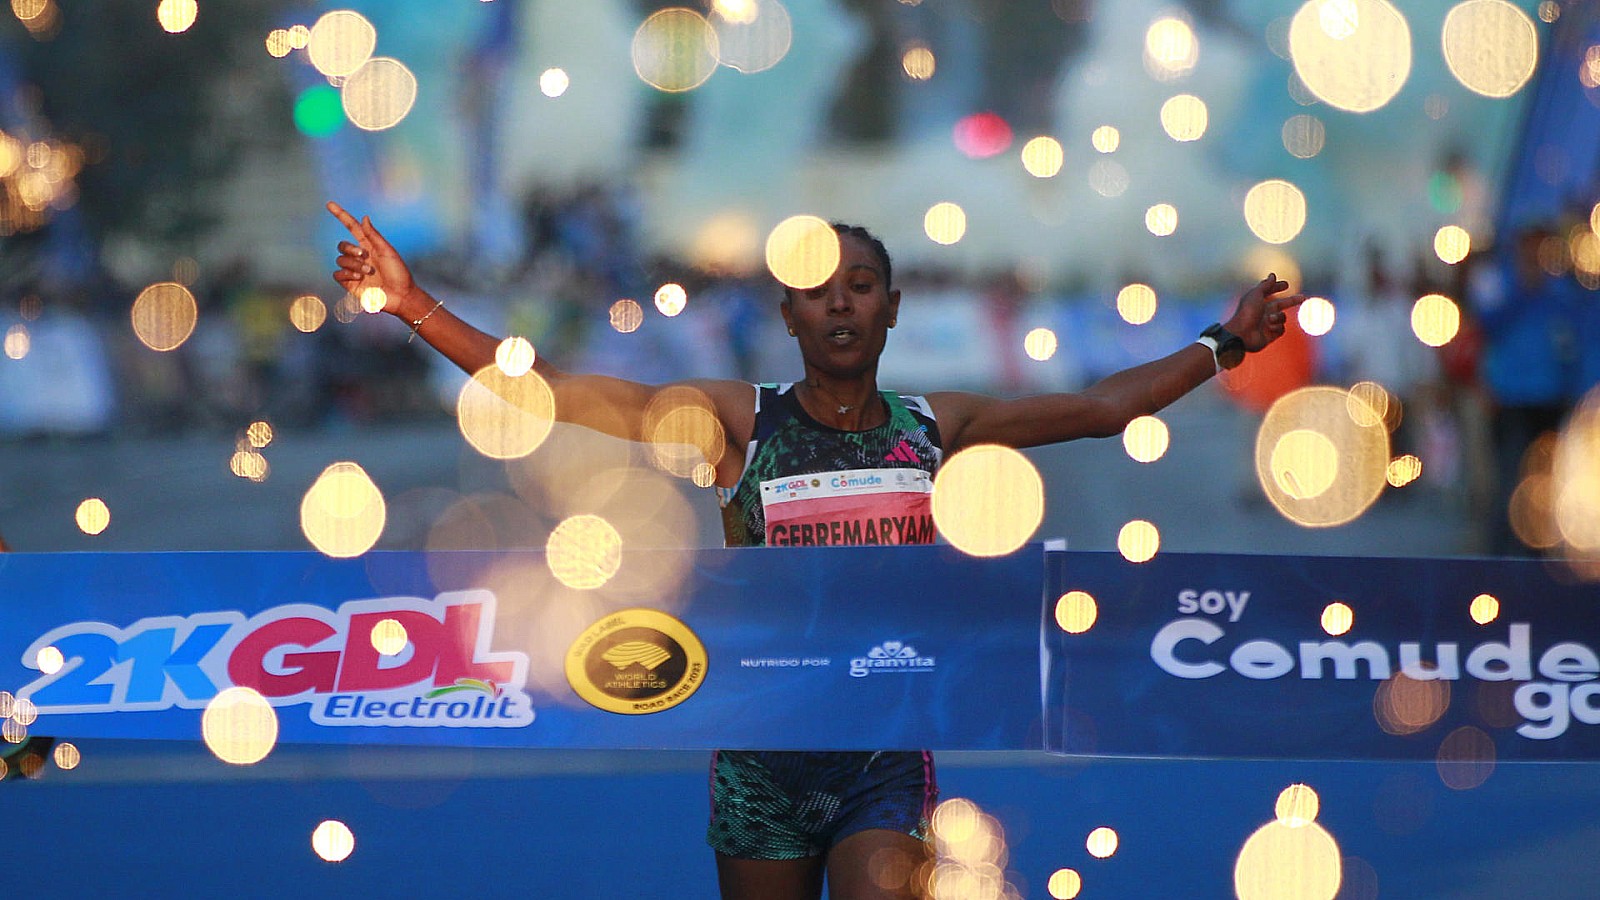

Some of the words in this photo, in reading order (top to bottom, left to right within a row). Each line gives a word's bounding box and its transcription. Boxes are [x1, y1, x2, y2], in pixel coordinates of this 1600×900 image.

[831, 475, 882, 488] Comude
[1177, 589, 1251, 622] soy
[1150, 618, 1600, 682] Comude
[740, 657, 799, 667] NUTRIDO
[802, 657, 831, 667] POR
[849, 657, 936, 677] granvita
[605, 681, 666, 689] ATHLETICS
[614, 673, 657, 681] WORLD
[324, 695, 516, 718] Electrolit
[632, 699, 665, 710] ROAD
[667, 684, 690, 702] RACE
